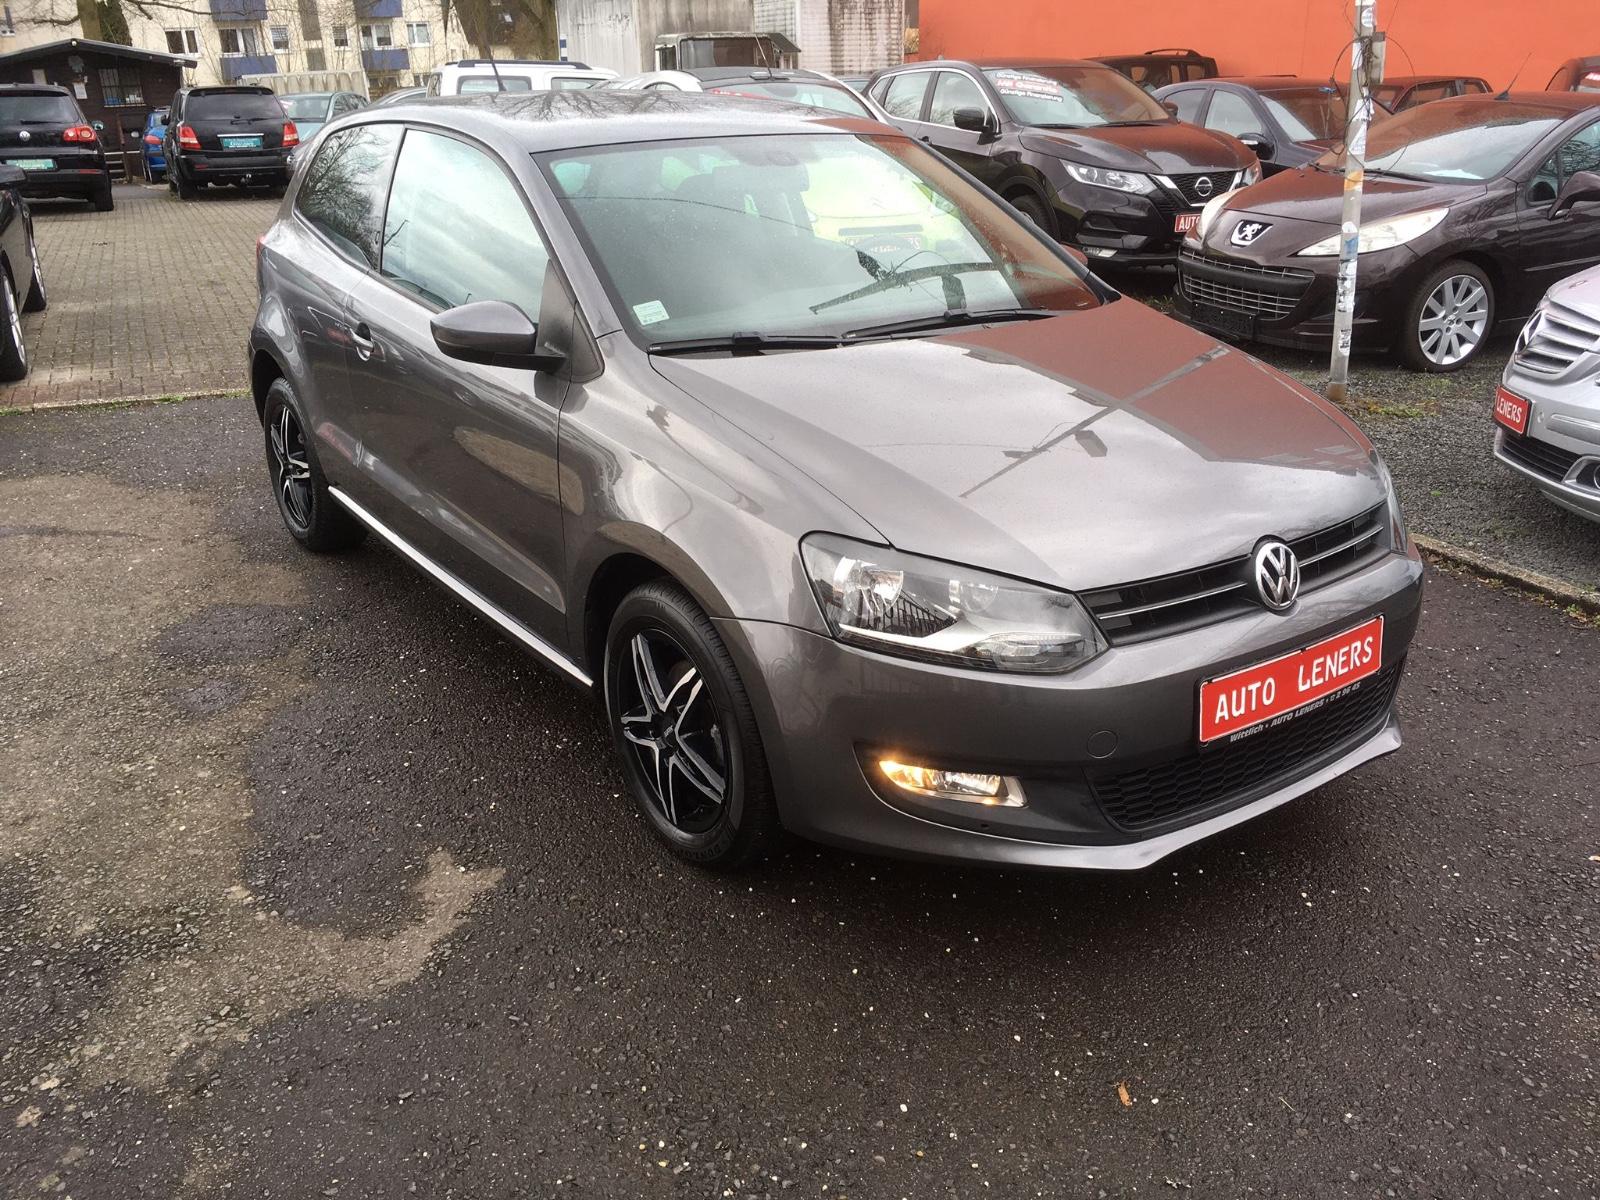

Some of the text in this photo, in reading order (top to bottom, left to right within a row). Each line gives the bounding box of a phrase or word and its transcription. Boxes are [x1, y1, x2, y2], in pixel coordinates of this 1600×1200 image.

[1497, 396, 1522, 423] LENERS
[1215, 636, 1374, 724] AUTO LENERS
[1230, 723, 1264, 742] Wittlich
[1271, 712, 1294, 728] AUTO
[1295, 698, 1325, 717] LENERS
